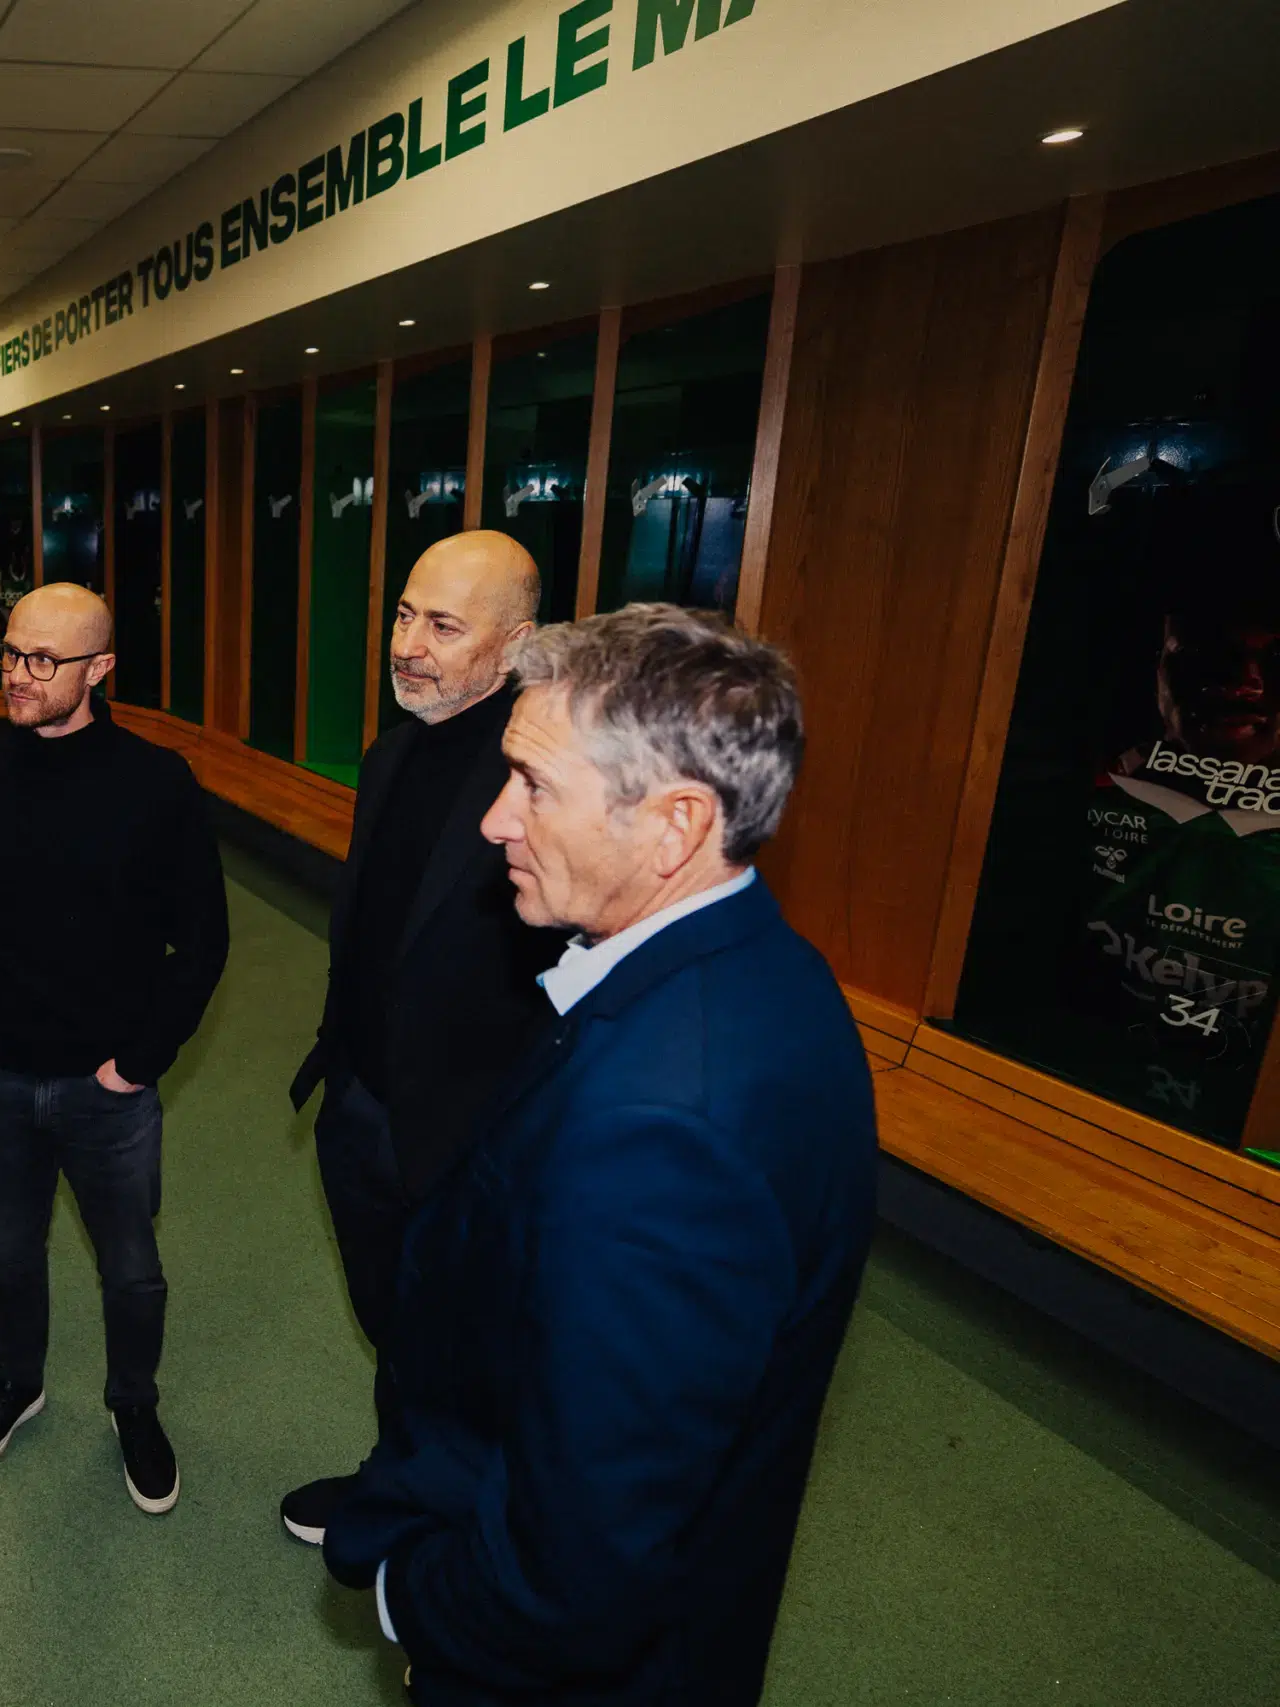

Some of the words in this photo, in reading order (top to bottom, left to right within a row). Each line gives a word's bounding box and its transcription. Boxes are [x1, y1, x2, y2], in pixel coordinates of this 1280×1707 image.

[32, 316, 53, 361] DE
[54, 270, 133, 351] PORTER
[137, 221, 214, 307] TOUS
[220, 57, 490, 270] ENSEMBLE
[503, 0, 613, 132] LE
[1147, 893, 1248, 939] Loire
[1159, 993, 1221, 1036] 34
